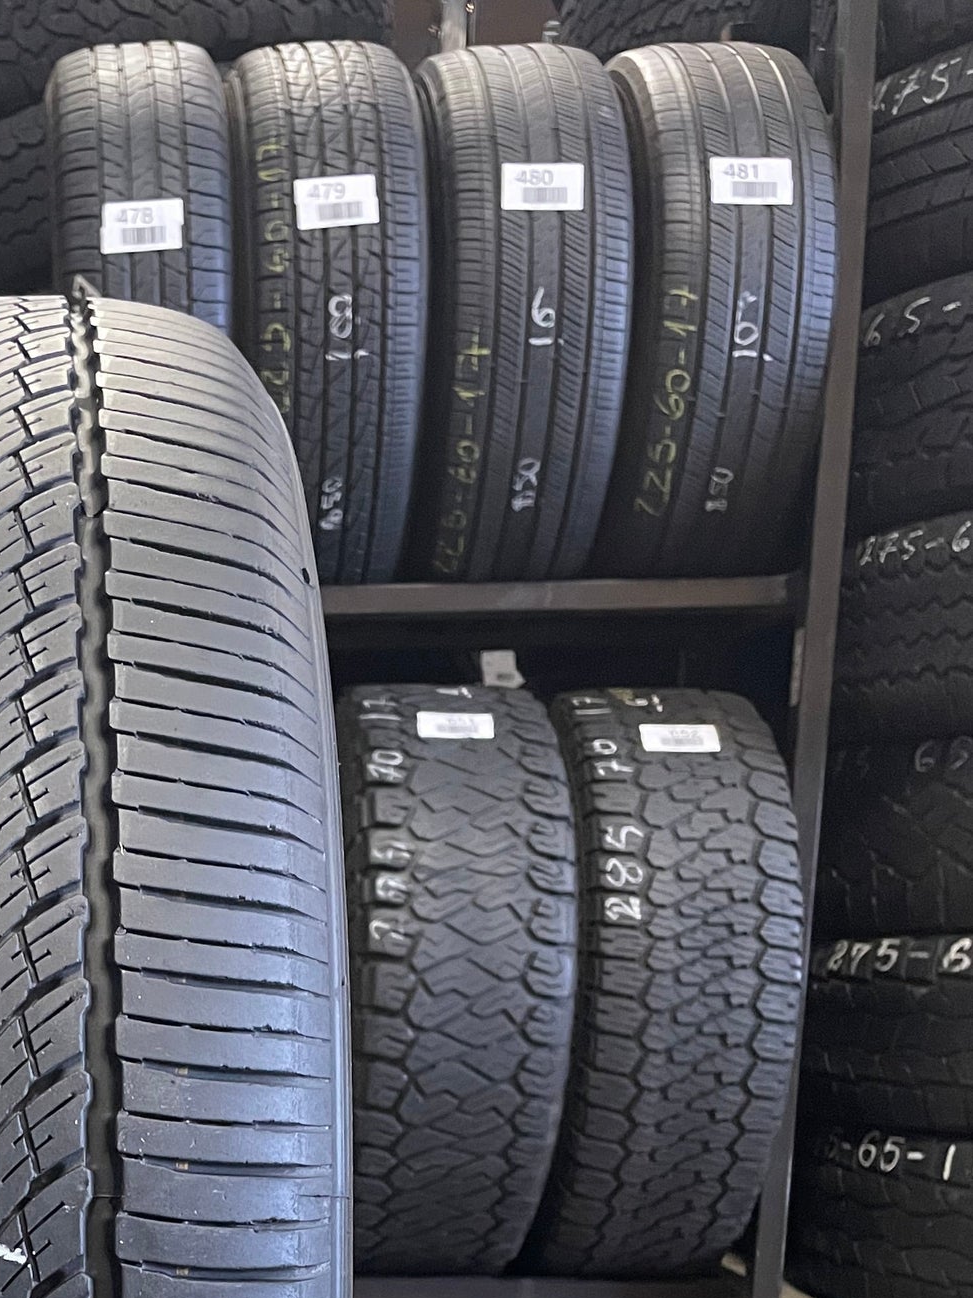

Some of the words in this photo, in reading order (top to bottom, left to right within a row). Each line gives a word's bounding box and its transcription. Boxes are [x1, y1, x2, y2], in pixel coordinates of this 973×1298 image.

[515, 168, 554, 187] 480
[722, 162, 761, 181] 481
[306, 182, 346, 202] 479
[115, 207, 154, 224] 478
[604, 824, 645, 922] 285
